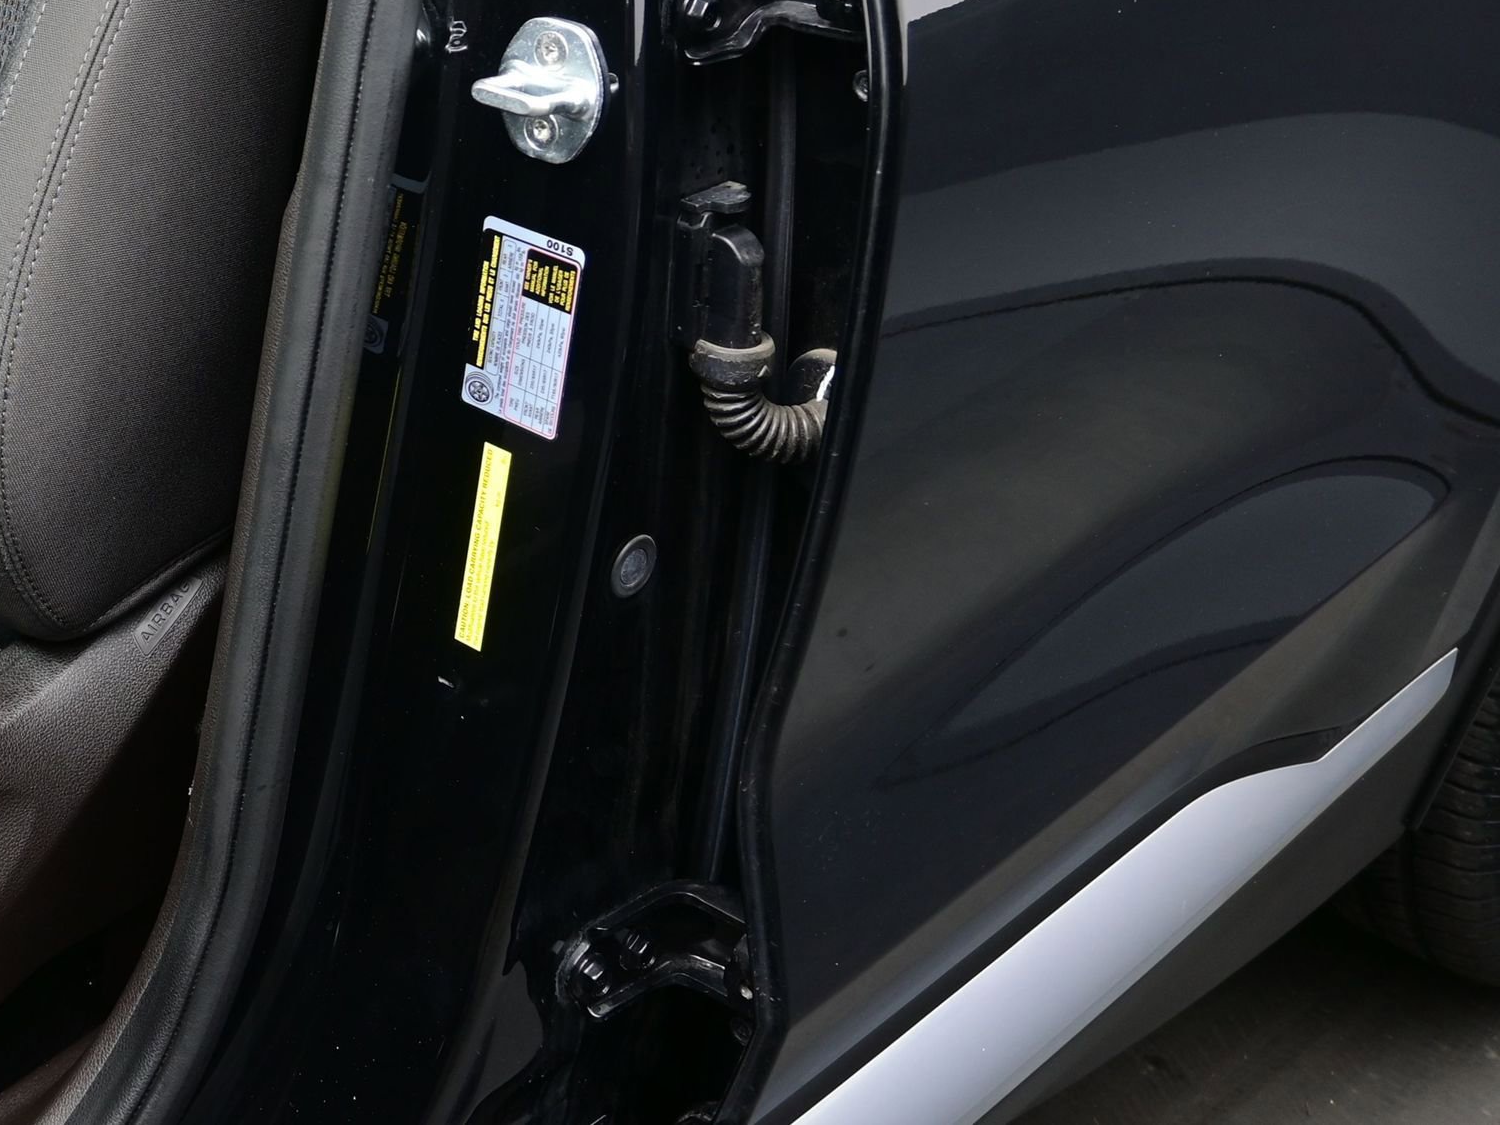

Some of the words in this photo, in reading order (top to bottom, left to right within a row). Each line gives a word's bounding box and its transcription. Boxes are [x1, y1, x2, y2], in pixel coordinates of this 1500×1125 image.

[546, 239, 574, 256] S100
[482, 449, 493, 489] REDUCED
[475, 490, 487, 530] CAPACITY
[468, 532, 480, 575] CARRYING
[465, 576, 474, 599] LOAD
